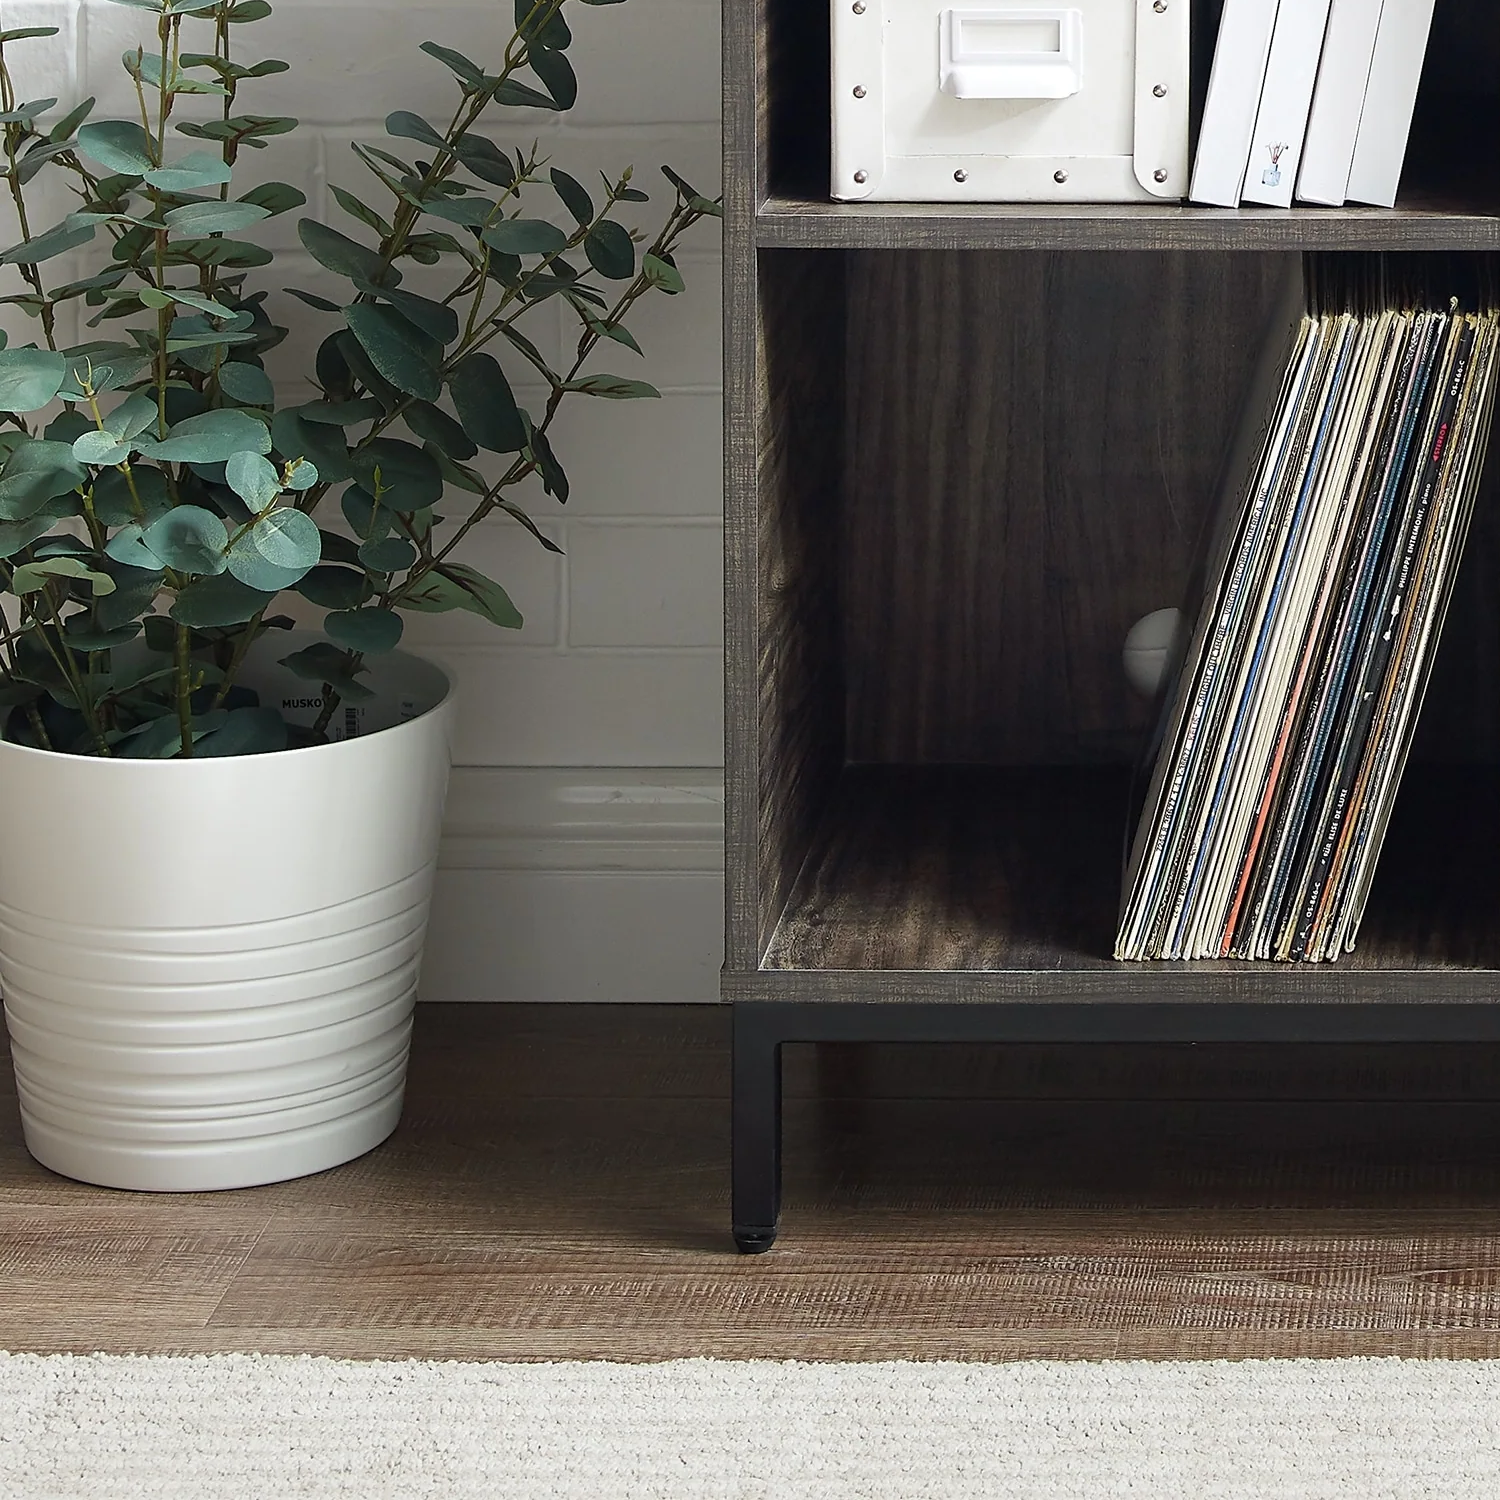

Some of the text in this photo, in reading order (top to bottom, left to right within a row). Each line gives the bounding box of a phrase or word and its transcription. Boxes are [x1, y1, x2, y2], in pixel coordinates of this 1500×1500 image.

[1225, 587, 1238, 616] VIRGIN
[1233, 544, 1250, 586] RECORDS
[282, 698, 326, 709] MUSKO
[1305, 882, 1321, 918] OS-866-C
[1328, 821, 1340, 842] ELISE
[1398, 555, 1412, 589] PHILIPPE
[1421, 482, 1432, 505] piano
